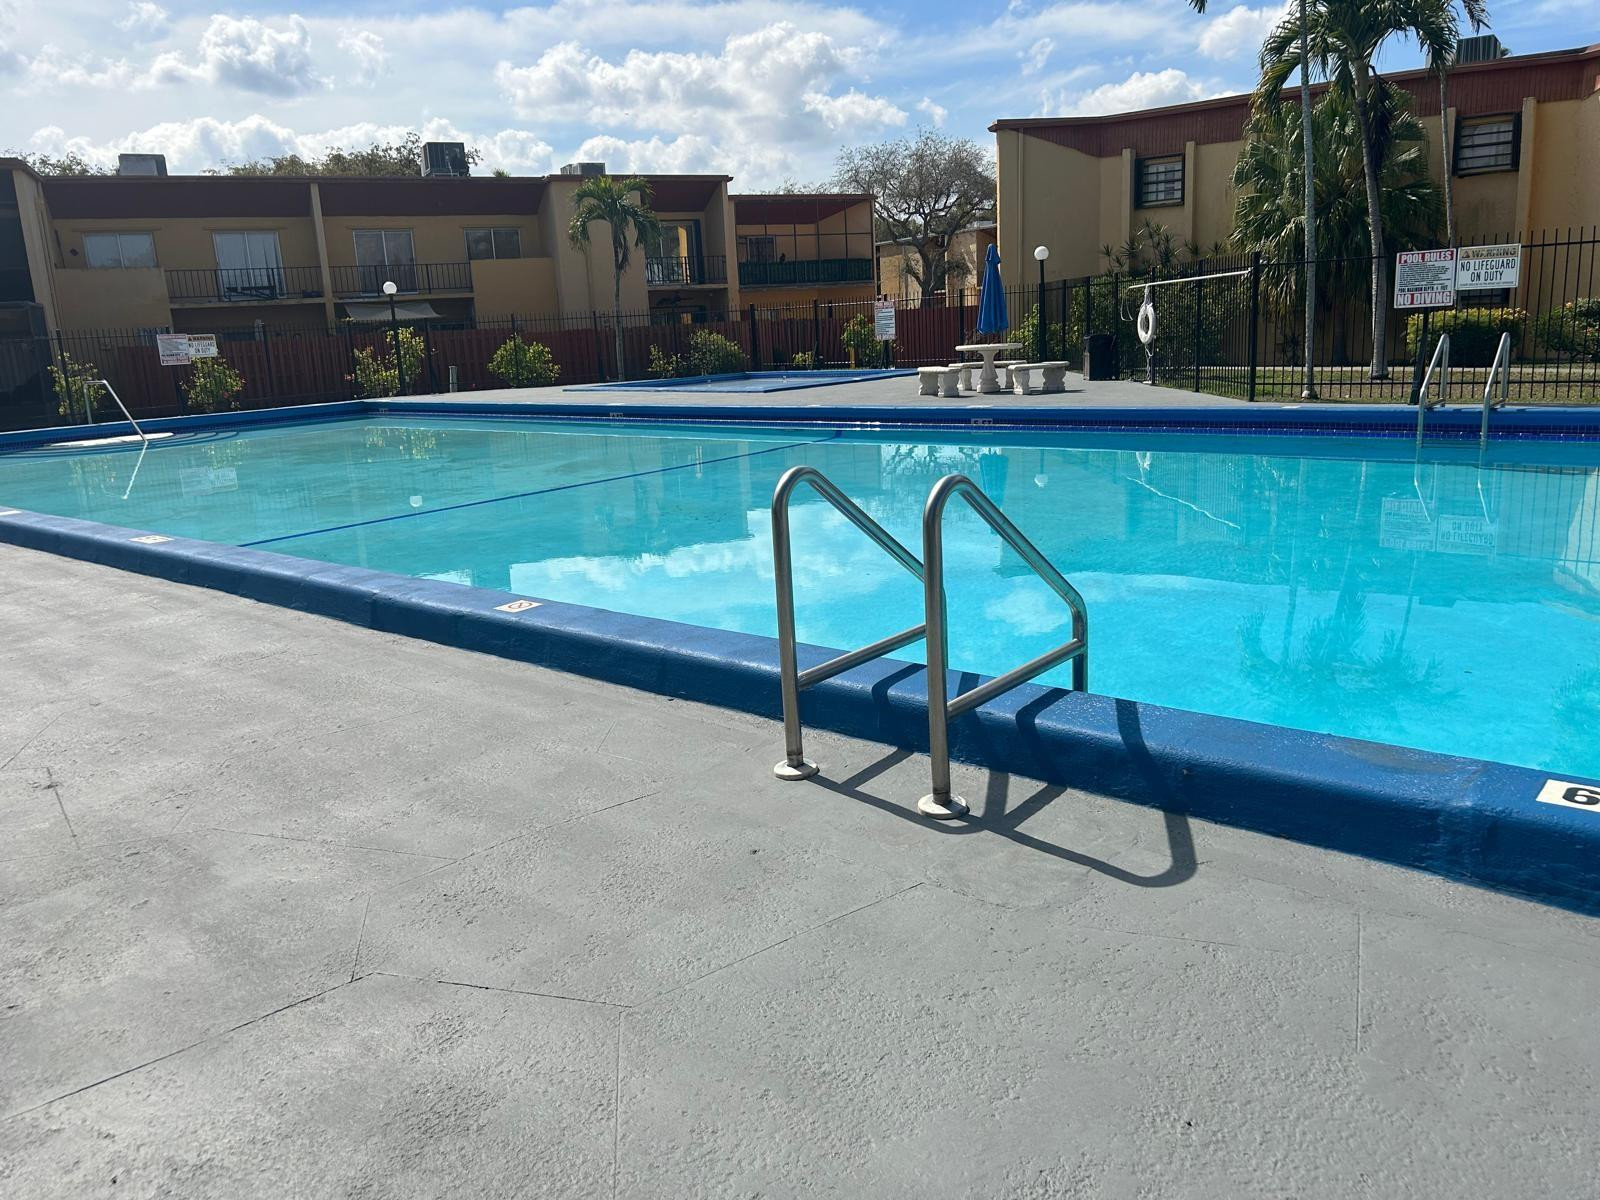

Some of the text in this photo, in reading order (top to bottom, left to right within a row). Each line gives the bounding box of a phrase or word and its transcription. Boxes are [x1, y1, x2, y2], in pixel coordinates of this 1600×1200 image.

[1401, 250, 1452, 264] POOL RULES
[1472, 247, 1516, 258] WARNING
[1460, 258, 1516, 271] NO LIFEGUARD
[1470, 270, 1504, 282] ON DUTY
[1397, 291, 1450, 305] NO DIVING
[1562, 787, 1600, 805] 6
